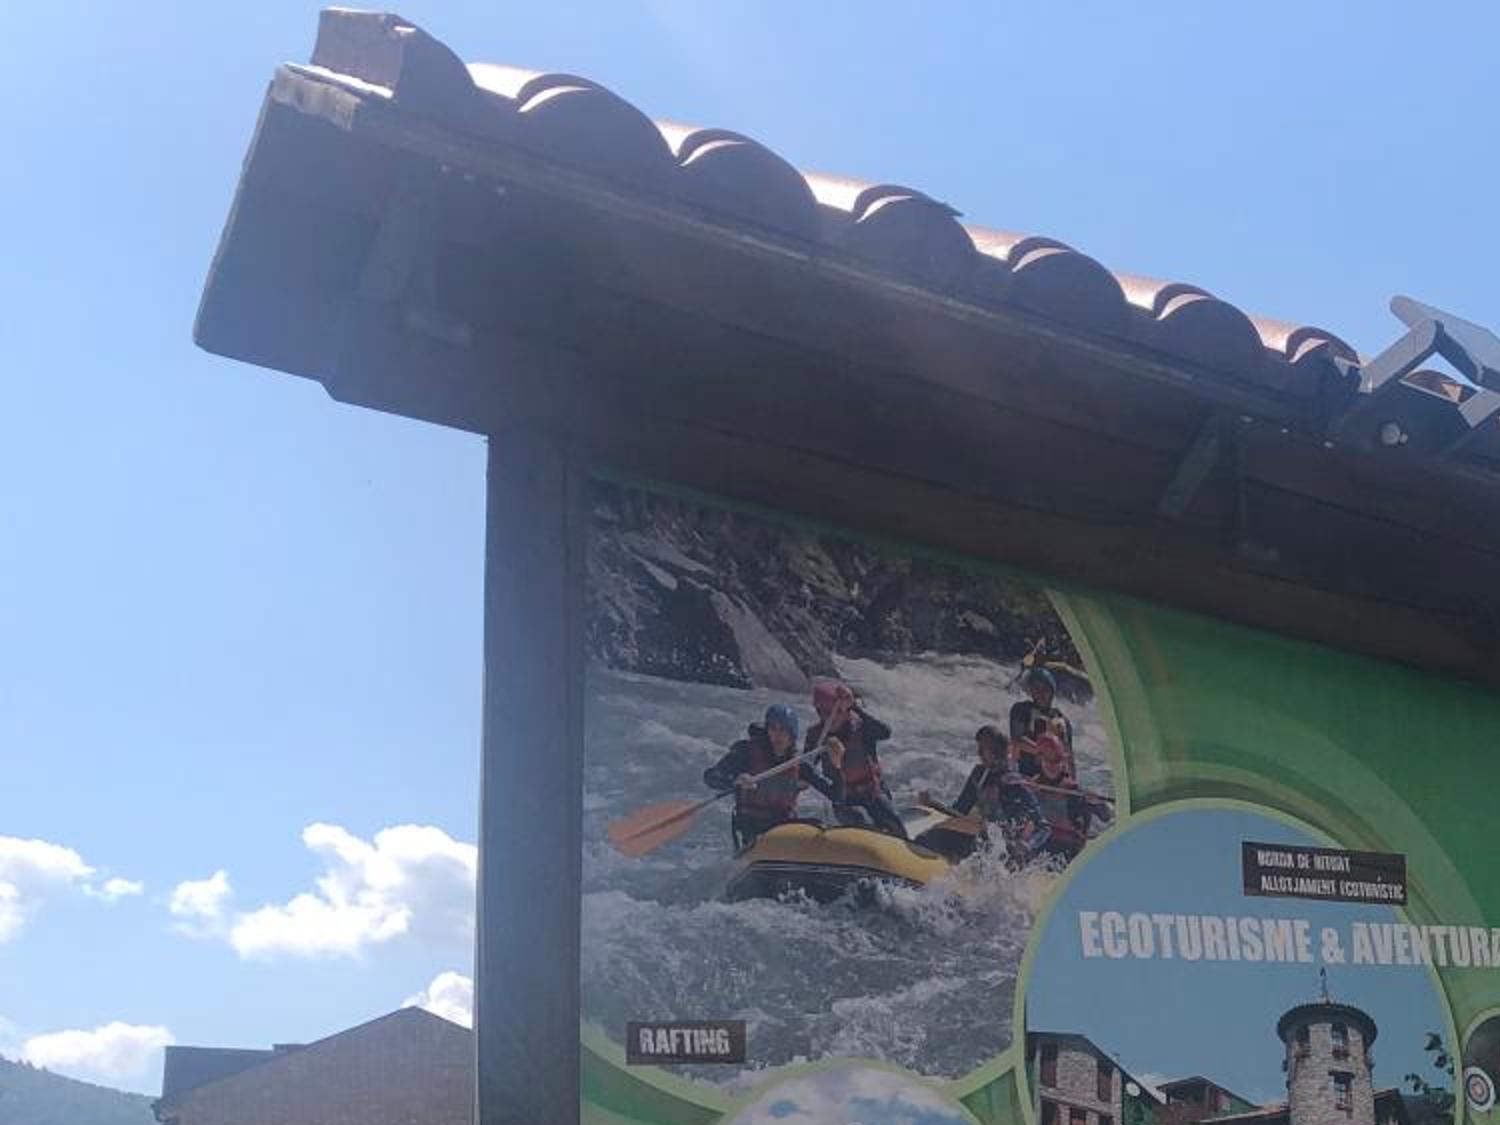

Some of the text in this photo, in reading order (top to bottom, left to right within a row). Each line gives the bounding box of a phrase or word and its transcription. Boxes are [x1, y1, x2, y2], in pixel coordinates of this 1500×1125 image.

[1079, 911, 1313, 963] ECOTURISME
[1321, 927, 1346, 964] &
[639, 1028, 730, 1054] RAFTING
